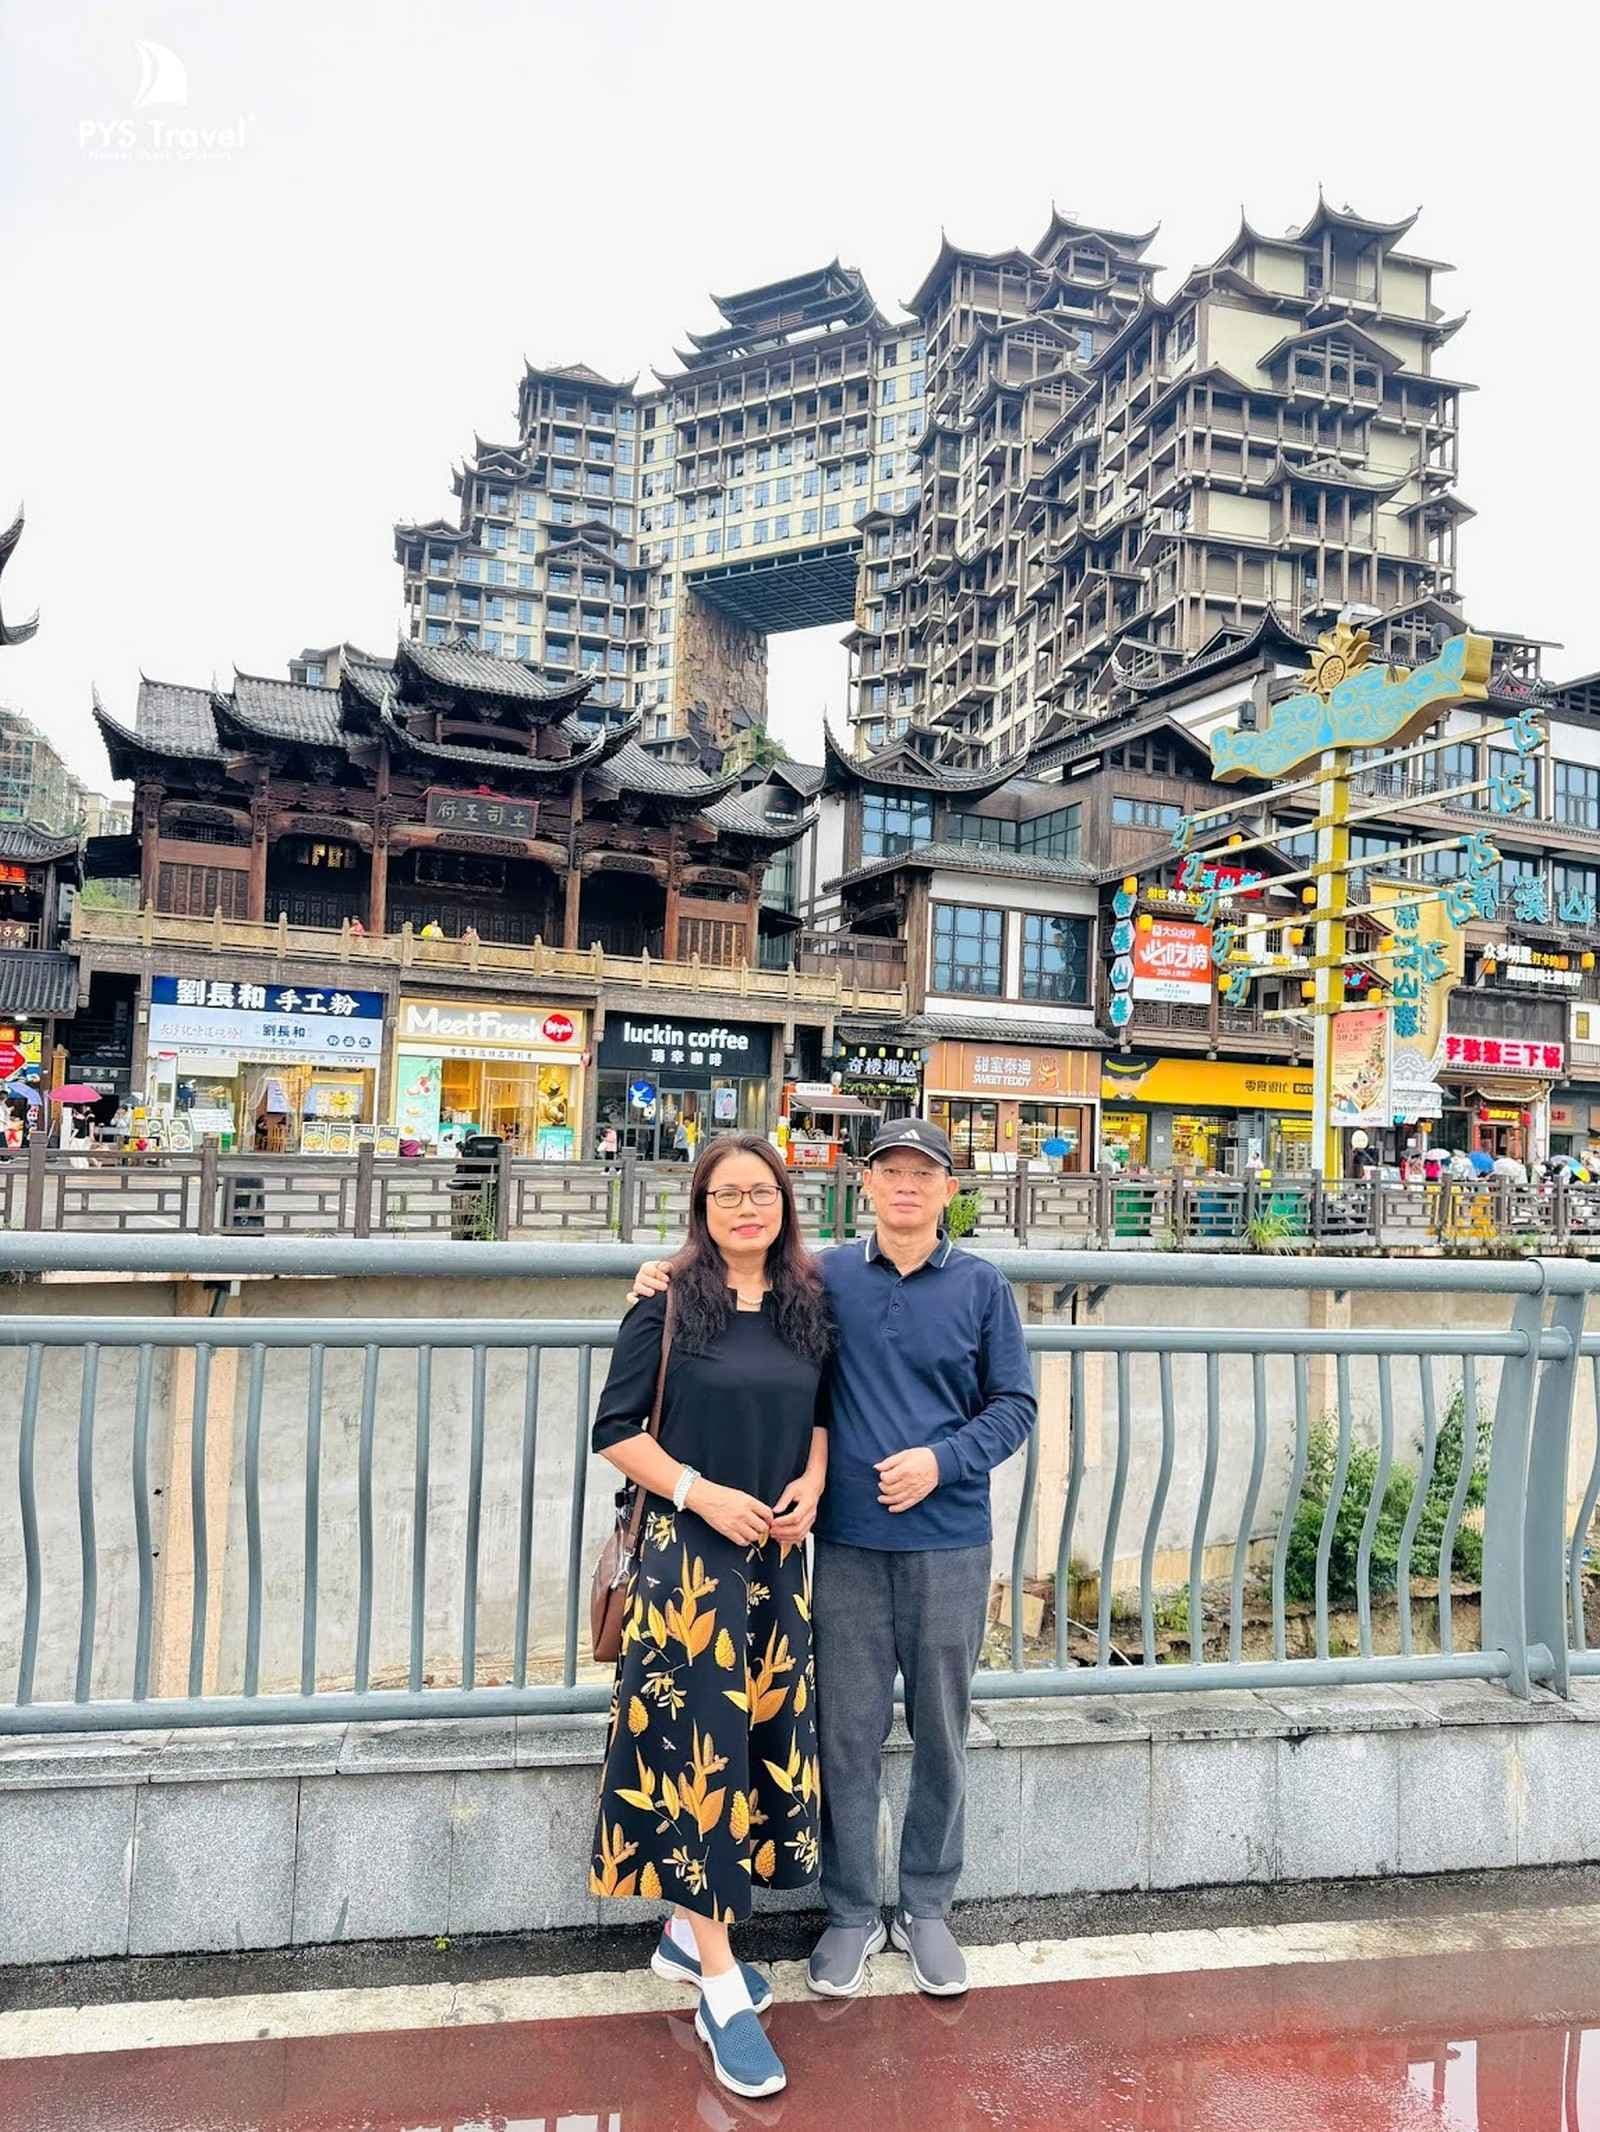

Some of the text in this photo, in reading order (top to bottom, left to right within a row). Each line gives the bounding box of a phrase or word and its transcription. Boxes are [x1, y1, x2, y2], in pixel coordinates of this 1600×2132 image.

[1139, 938, 1209, 971] 必吃榜
[176, 978, 361, 1017] 劉長和 手工粉
[623, 1021, 749, 1051] luckin coffee
